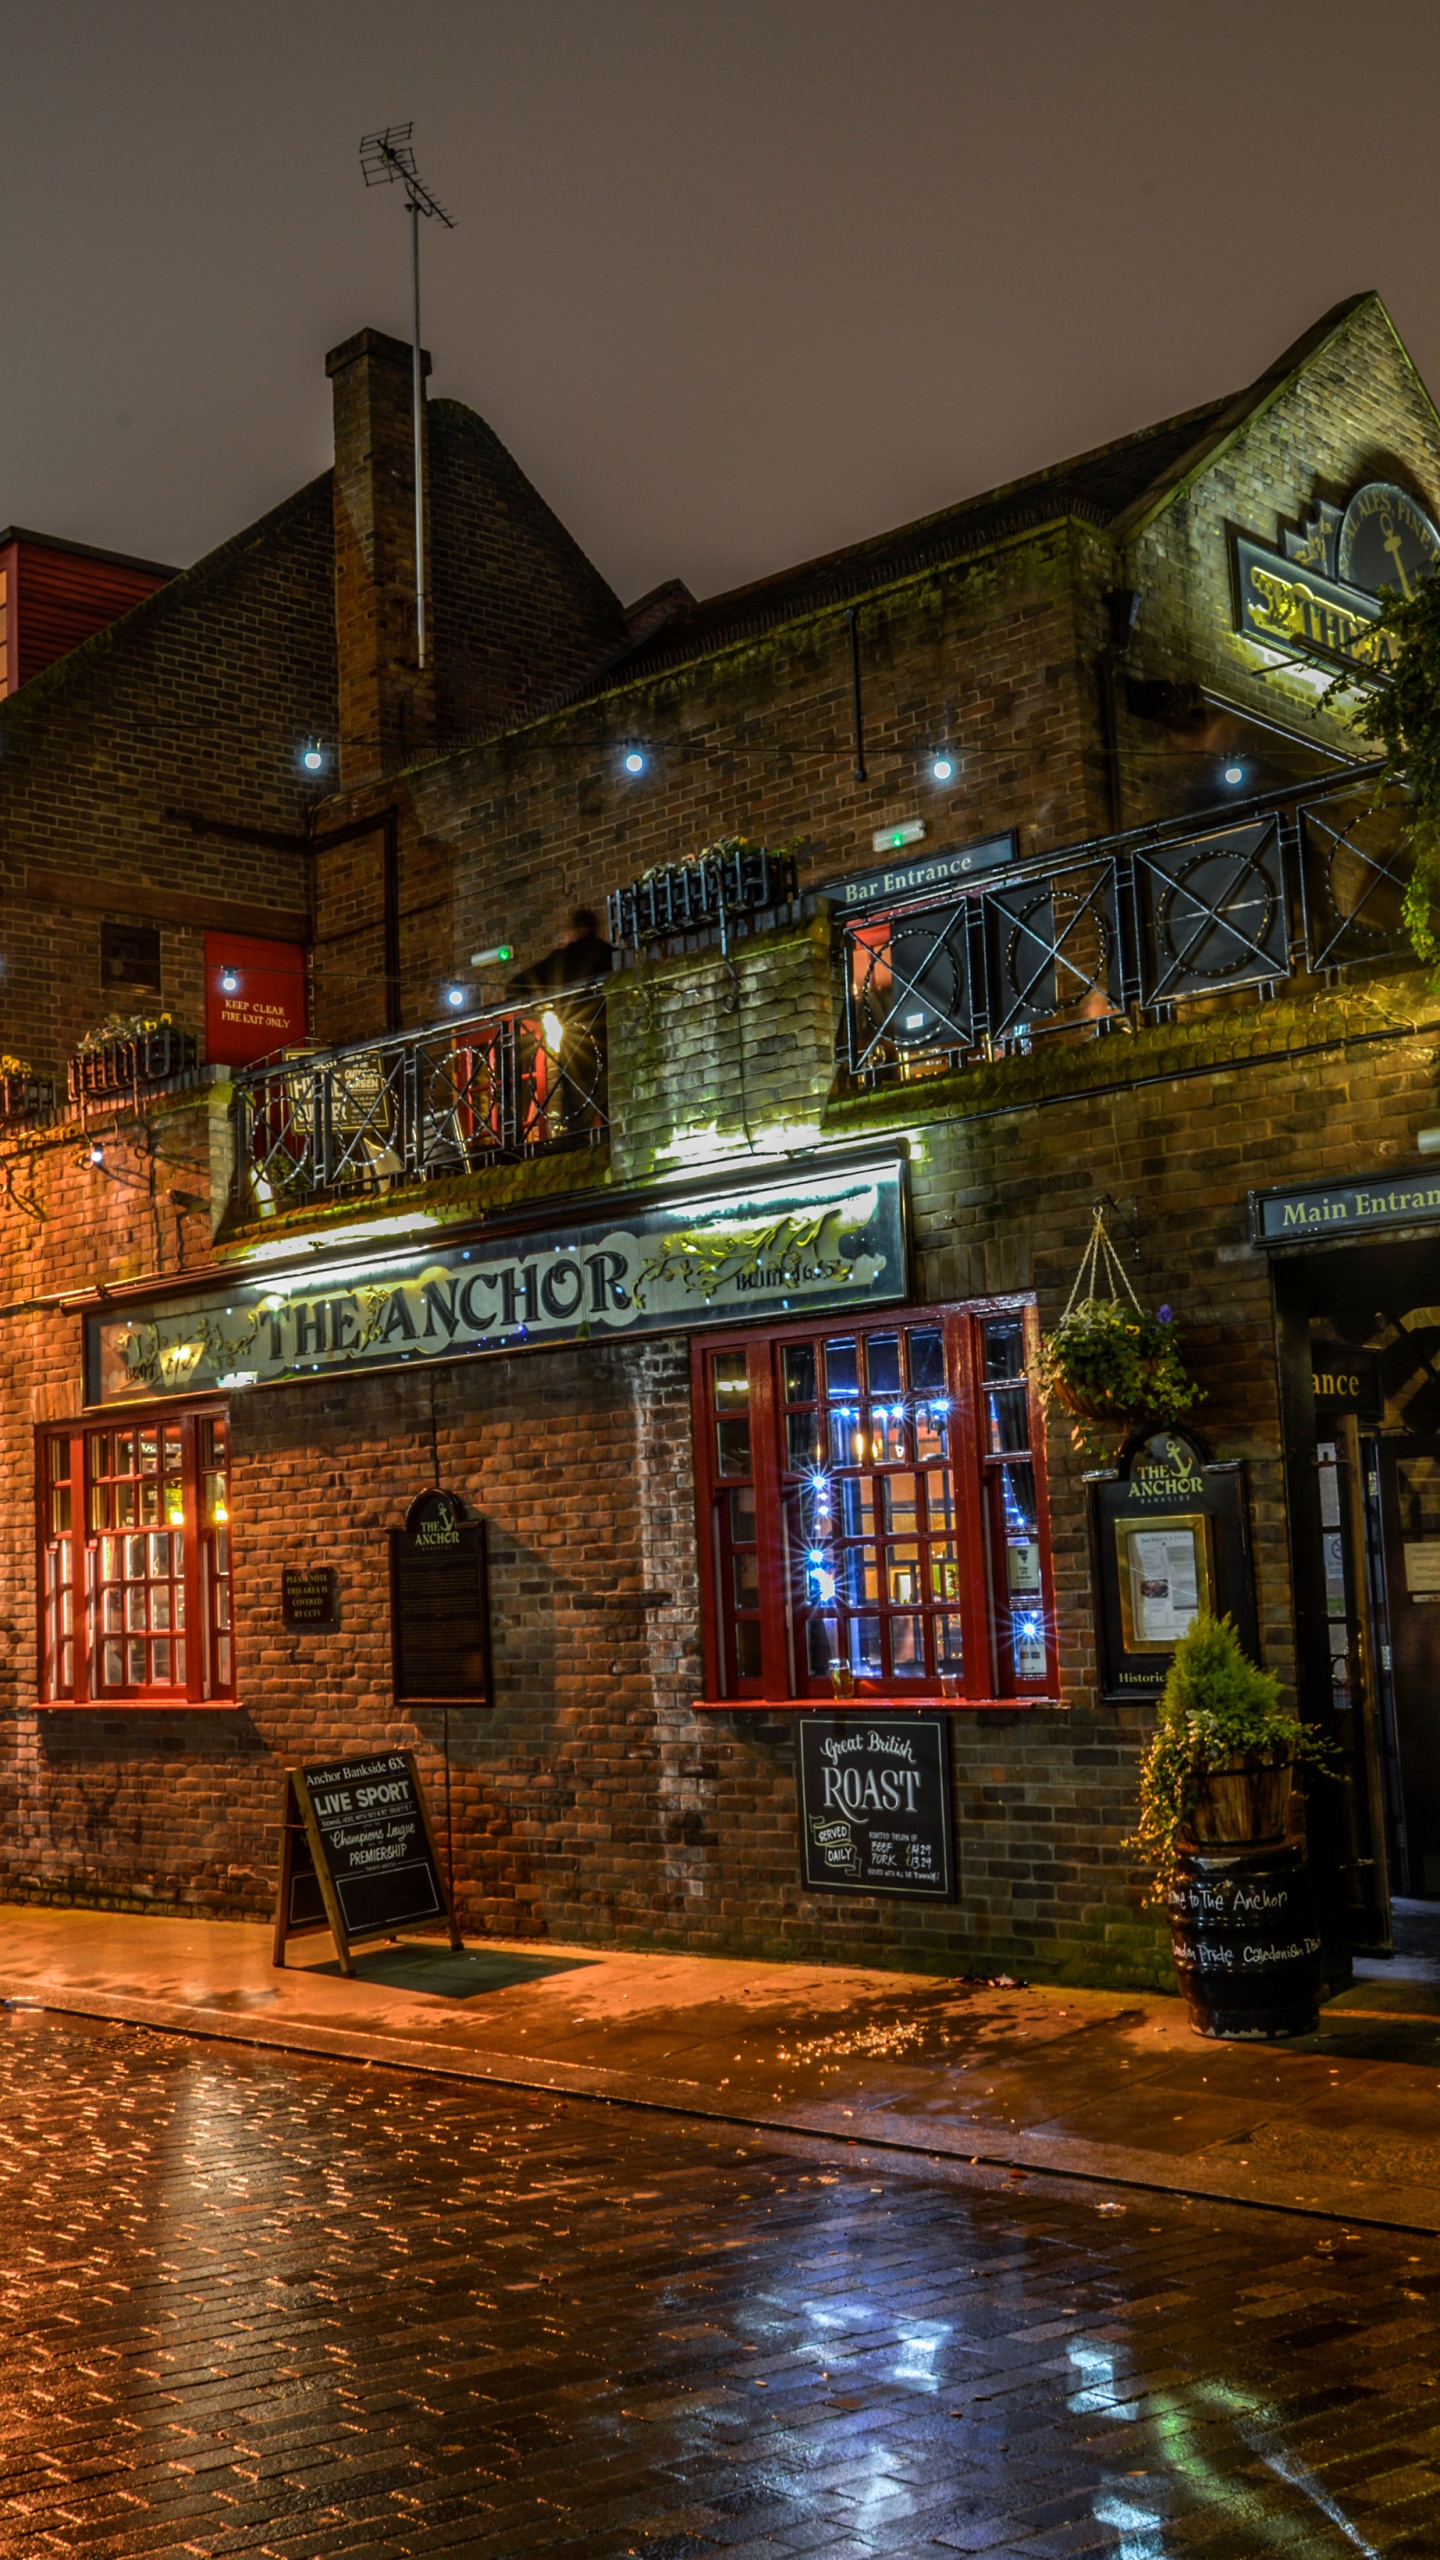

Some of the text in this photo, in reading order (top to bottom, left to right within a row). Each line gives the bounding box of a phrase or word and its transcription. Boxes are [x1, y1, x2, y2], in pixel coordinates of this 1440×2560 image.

[1397, 499, 1431, 550] FINE
[845, 857, 972, 903] Bar Entrance
[225, 999, 285, 1017] KEEP CLEAR
[221, 1011, 291, 1029] FIRE EXIT ONLY
[1282, 1198, 1348, 1227] Main
[256, 1250, 632, 1361] THE ANCHOR
[1137, 1464, 1170, 1480] THE
[1128, 1476, 1203, 1498] ANCHOR
[1140, 1495, 1191, 1504] BANKSIDE
[421, 1521, 440, 1533] THE
[415, 1532, 460, 1546] ANCHOR
[286, 1574, 327, 1584] PLEASE NOTE
[287, 1587, 302, 1595] THIS
[303, 1586, 320, 1594] AREA
[292, 1598, 323, 1606] COVERED
[294, 1609, 321, 1618] BY CCTV
[1119, 1672, 1167, 1684] Historic
[820, 1730, 917, 1765] Great British
[306, 1756, 404, 1787] Anchor Bankside 6X
[314, 1781, 409, 1816] LIVE SPORT
[822, 1767, 921, 1824] ROAST
[329, 1829, 384, 1849] Champions
[386, 1822, 416, 1842] League
[818, 1825, 848, 1842] SERVED
[349, 1843, 407, 1866] PREMIERSHIP
[828, 1847, 853, 1862] DAILY
[871, 1853, 898, 1866] PORK
[871, 1841, 893, 1854] BEEF
[1188, 1889, 1199, 1908] to
[1199, 1890, 1225, 1911] The
[1233, 1890, 1288, 1911] Anchor
[1197, 1943, 1234, 1963] Pride
[1243, 1943, 1304, 1963] Caledonian
